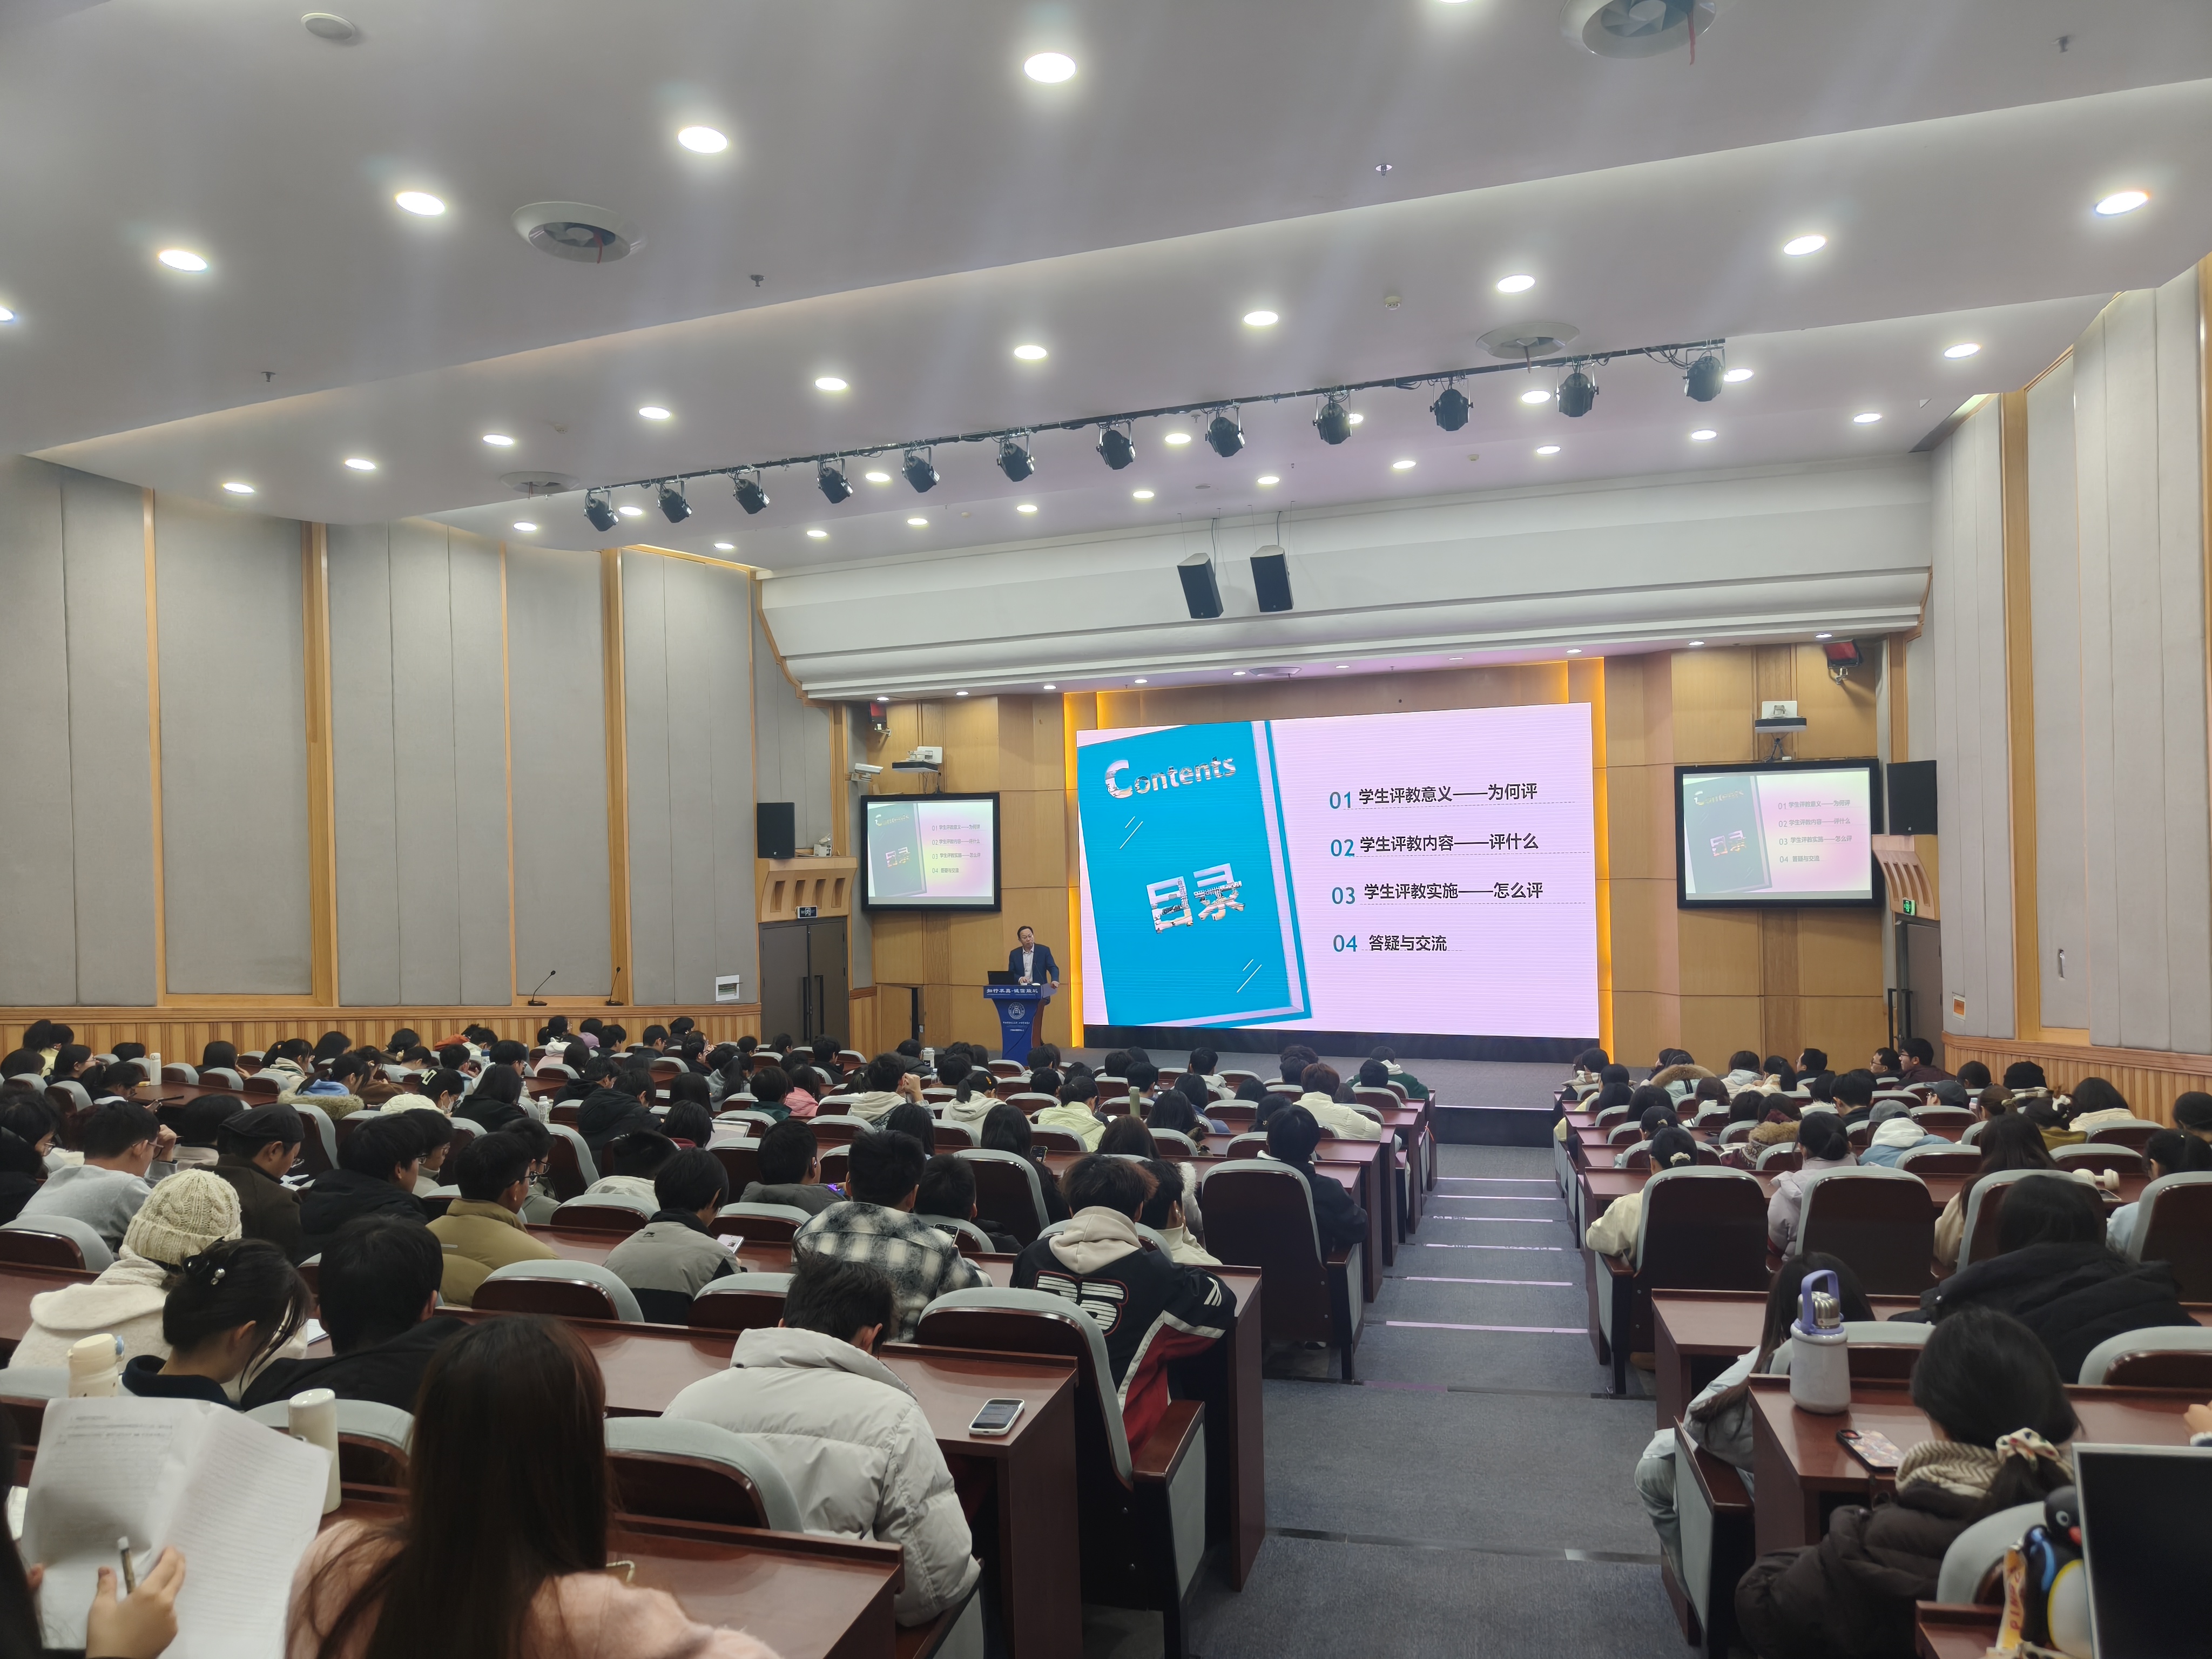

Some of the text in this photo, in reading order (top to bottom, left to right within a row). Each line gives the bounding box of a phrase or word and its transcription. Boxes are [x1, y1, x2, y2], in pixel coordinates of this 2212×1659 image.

[1104, 757, 1237, 799] Contents
[1330, 783, 1538, 809] 01 学生评教意义——为何评
[1331, 833, 1539, 857] 02 学生评教内容——评什么
[1146, 863, 1245, 934] 目录
[1332, 882, 1543, 905] 03 学生评教实施——怎么评
[1333, 934, 1447, 952] 04 答疑与交流
